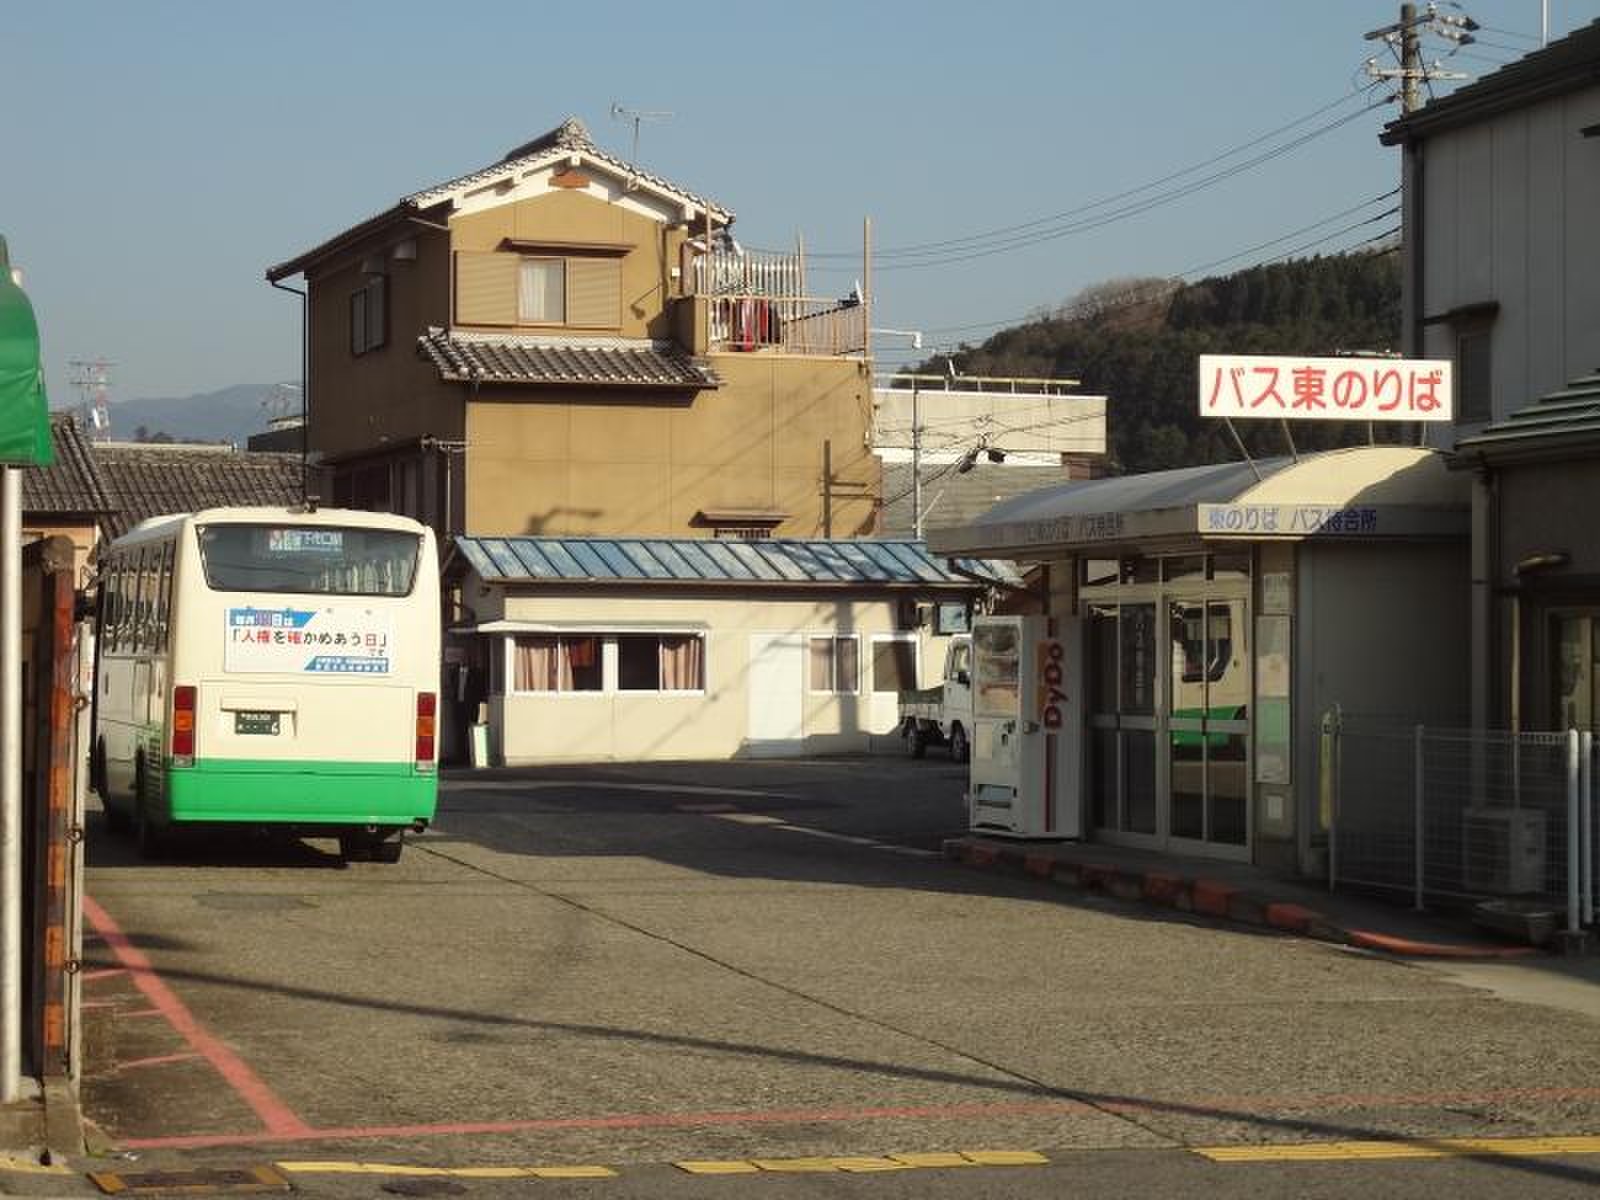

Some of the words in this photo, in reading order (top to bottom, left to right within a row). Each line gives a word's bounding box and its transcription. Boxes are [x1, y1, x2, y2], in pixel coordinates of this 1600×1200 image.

[1209, 365, 1443, 412] バス東のりば
[1044, 643, 1068, 729] DyDo
